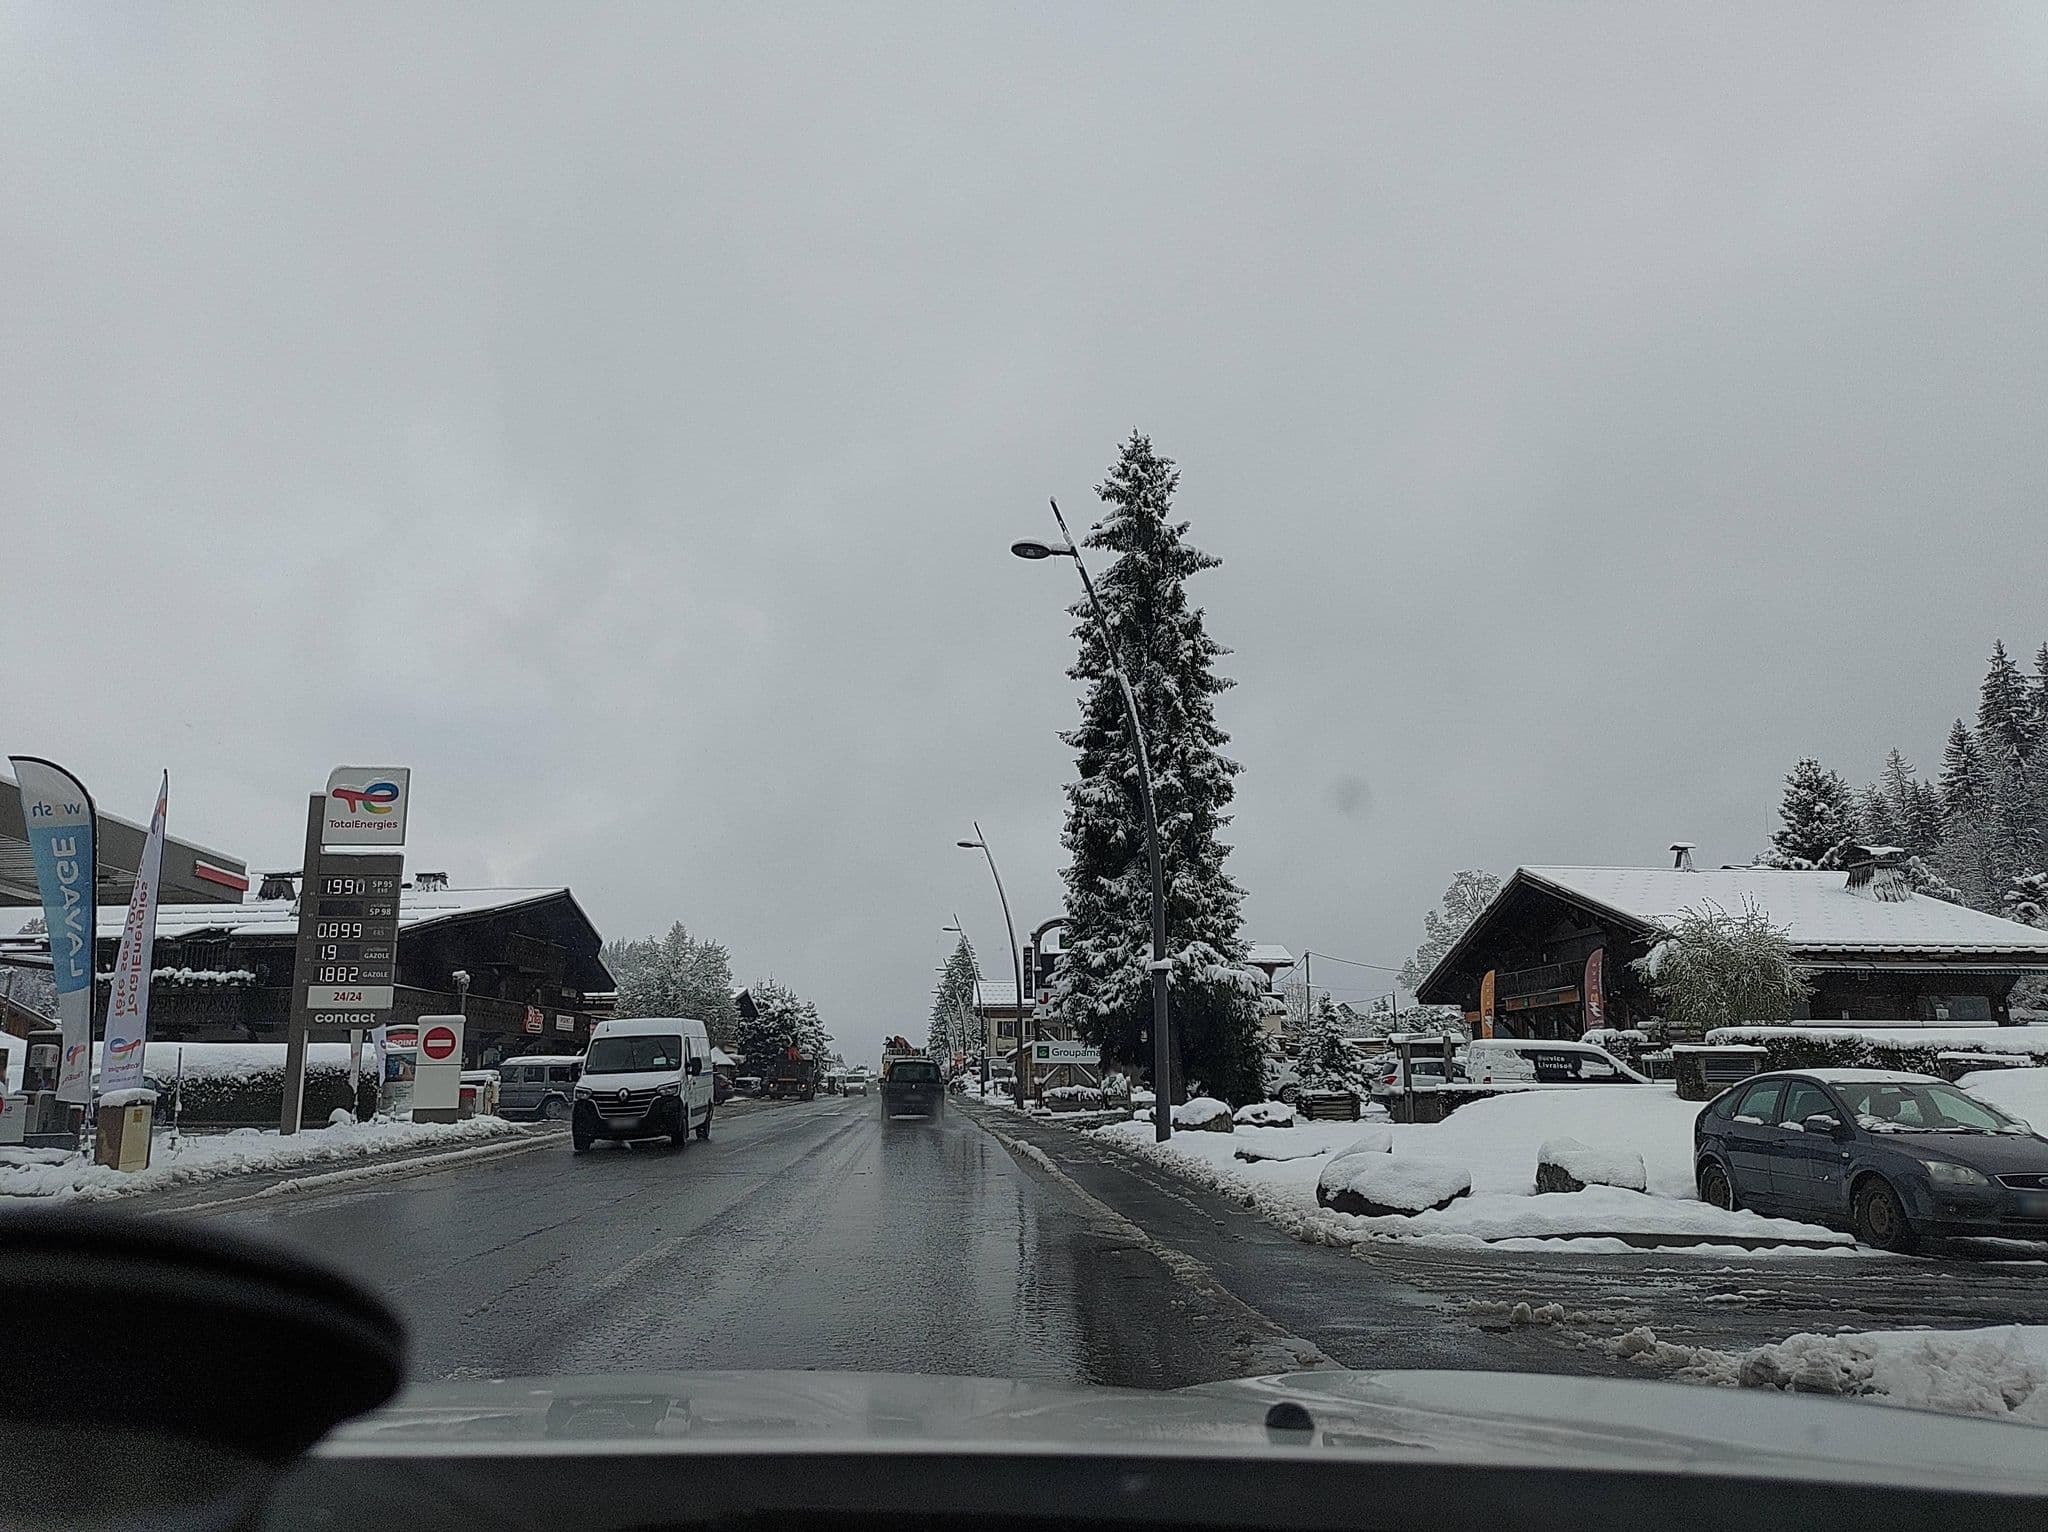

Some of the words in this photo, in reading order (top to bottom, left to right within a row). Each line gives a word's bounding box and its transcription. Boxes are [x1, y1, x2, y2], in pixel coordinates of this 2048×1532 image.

[328, 819, 398, 831] TotalEnergies
[369, 907, 380, 916] SP
[381, 907, 392, 916] 98
[317, 922, 362, 938] 0.899
[319, 966, 359, 982] 1.882
[333, 991, 362, 1002] 24/24
[314, 1013, 376, 1023] contact
[1051, 1047, 1101, 1059] Groupama
